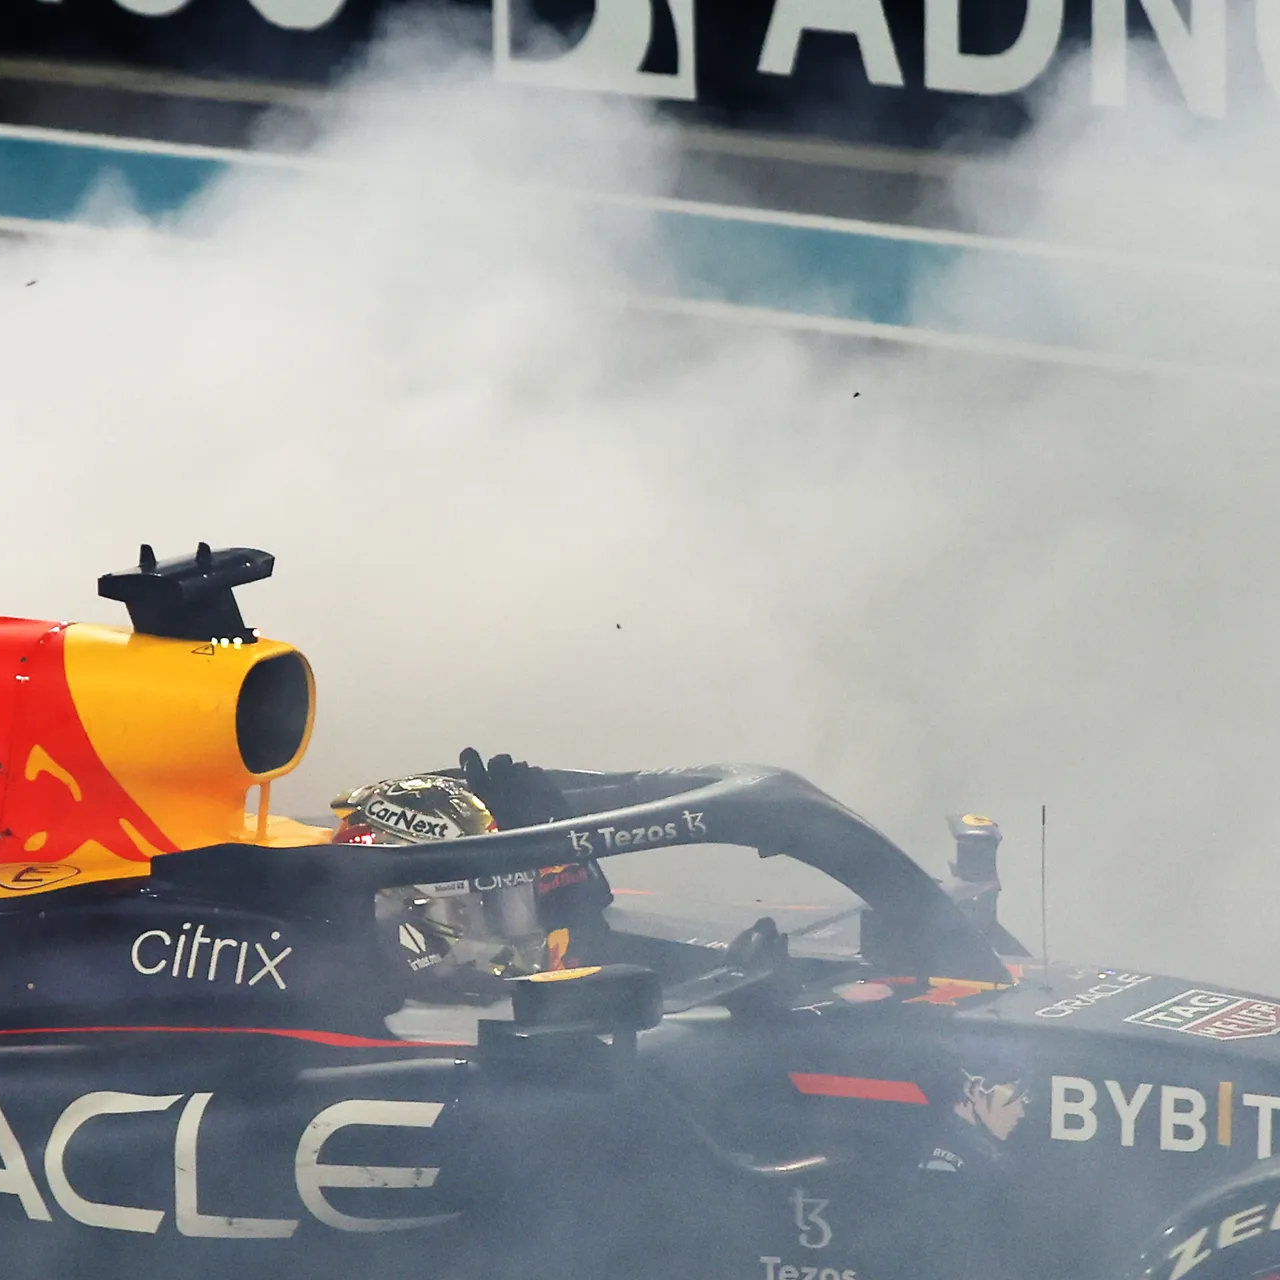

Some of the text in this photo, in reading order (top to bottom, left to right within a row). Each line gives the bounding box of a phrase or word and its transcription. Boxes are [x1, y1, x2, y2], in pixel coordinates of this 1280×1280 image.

[368, 798, 450, 838] CarNext
[597, 821, 677, 848] Tezos
[130, 922, 293, 990] citrix
[1034, 973, 1153, 1018] ORACLE
[1143, 995, 1228, 1023] TAG
[1198, 1003, 1277, 1036] HEUER
